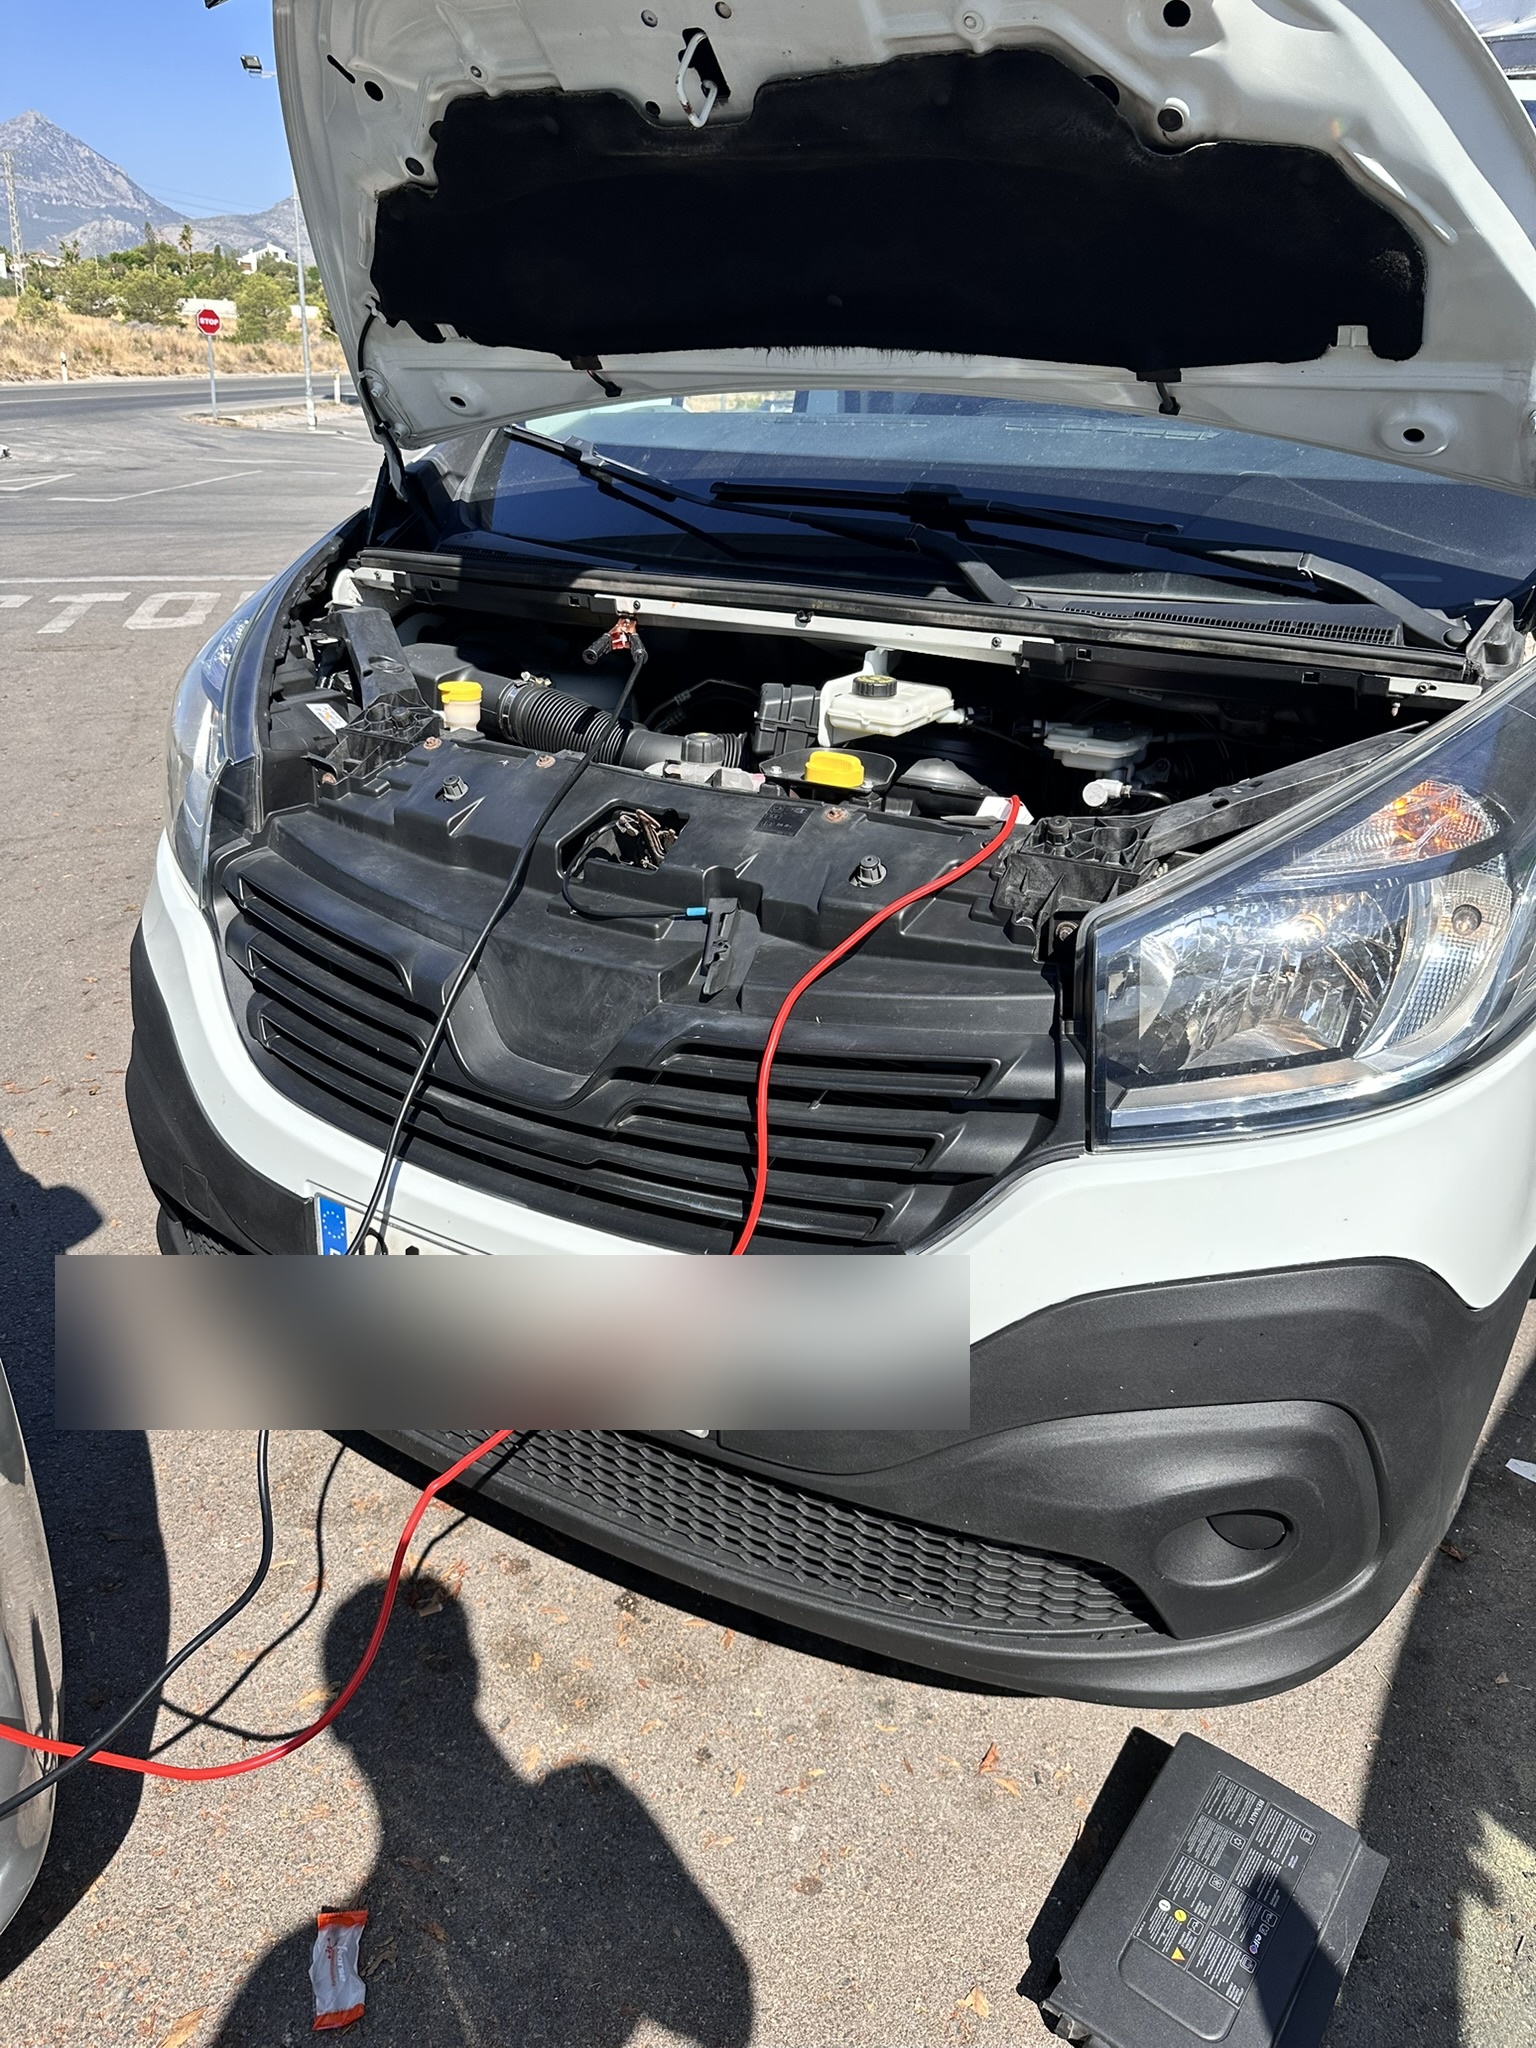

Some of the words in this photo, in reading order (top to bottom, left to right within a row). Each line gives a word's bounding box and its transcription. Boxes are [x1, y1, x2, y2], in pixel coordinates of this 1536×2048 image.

[200, 317, 218, 325] STOP
[0, 591, 256, 634] TO
[1247, 1798, 1265, 1826] RENAULT
